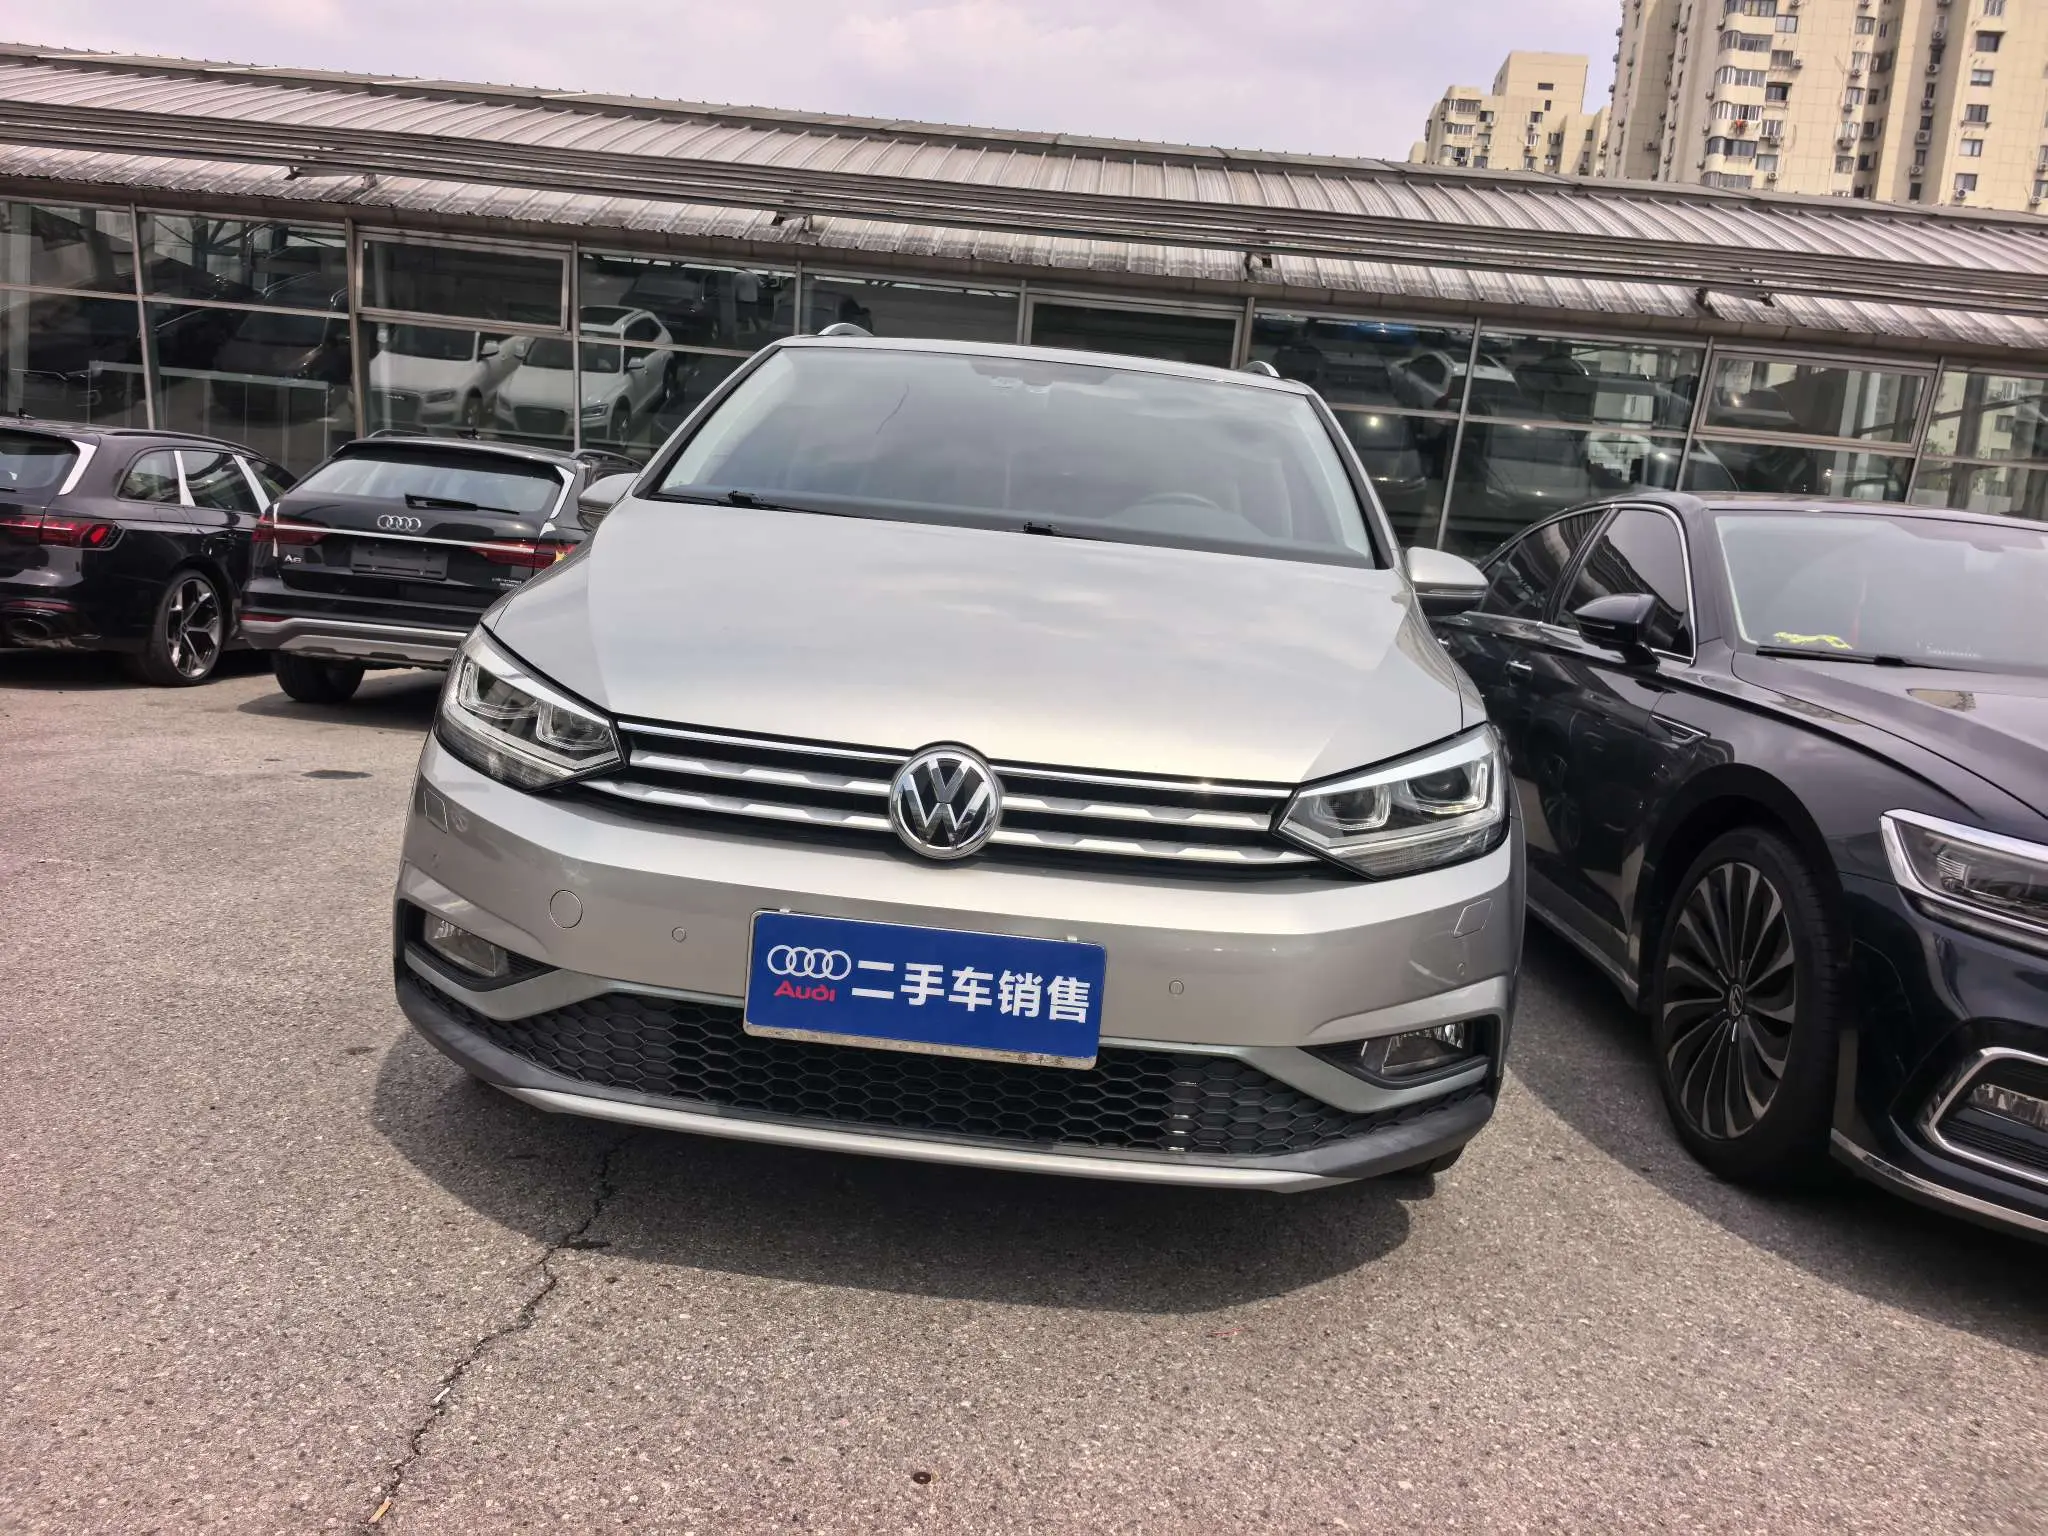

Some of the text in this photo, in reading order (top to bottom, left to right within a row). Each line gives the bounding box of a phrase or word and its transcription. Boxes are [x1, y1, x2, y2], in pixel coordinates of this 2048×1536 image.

[894, 752, 995, 853] VW
[773, 980, 835, 1002] Audi
[851, 960, 1091, 1023] 二手车销售
